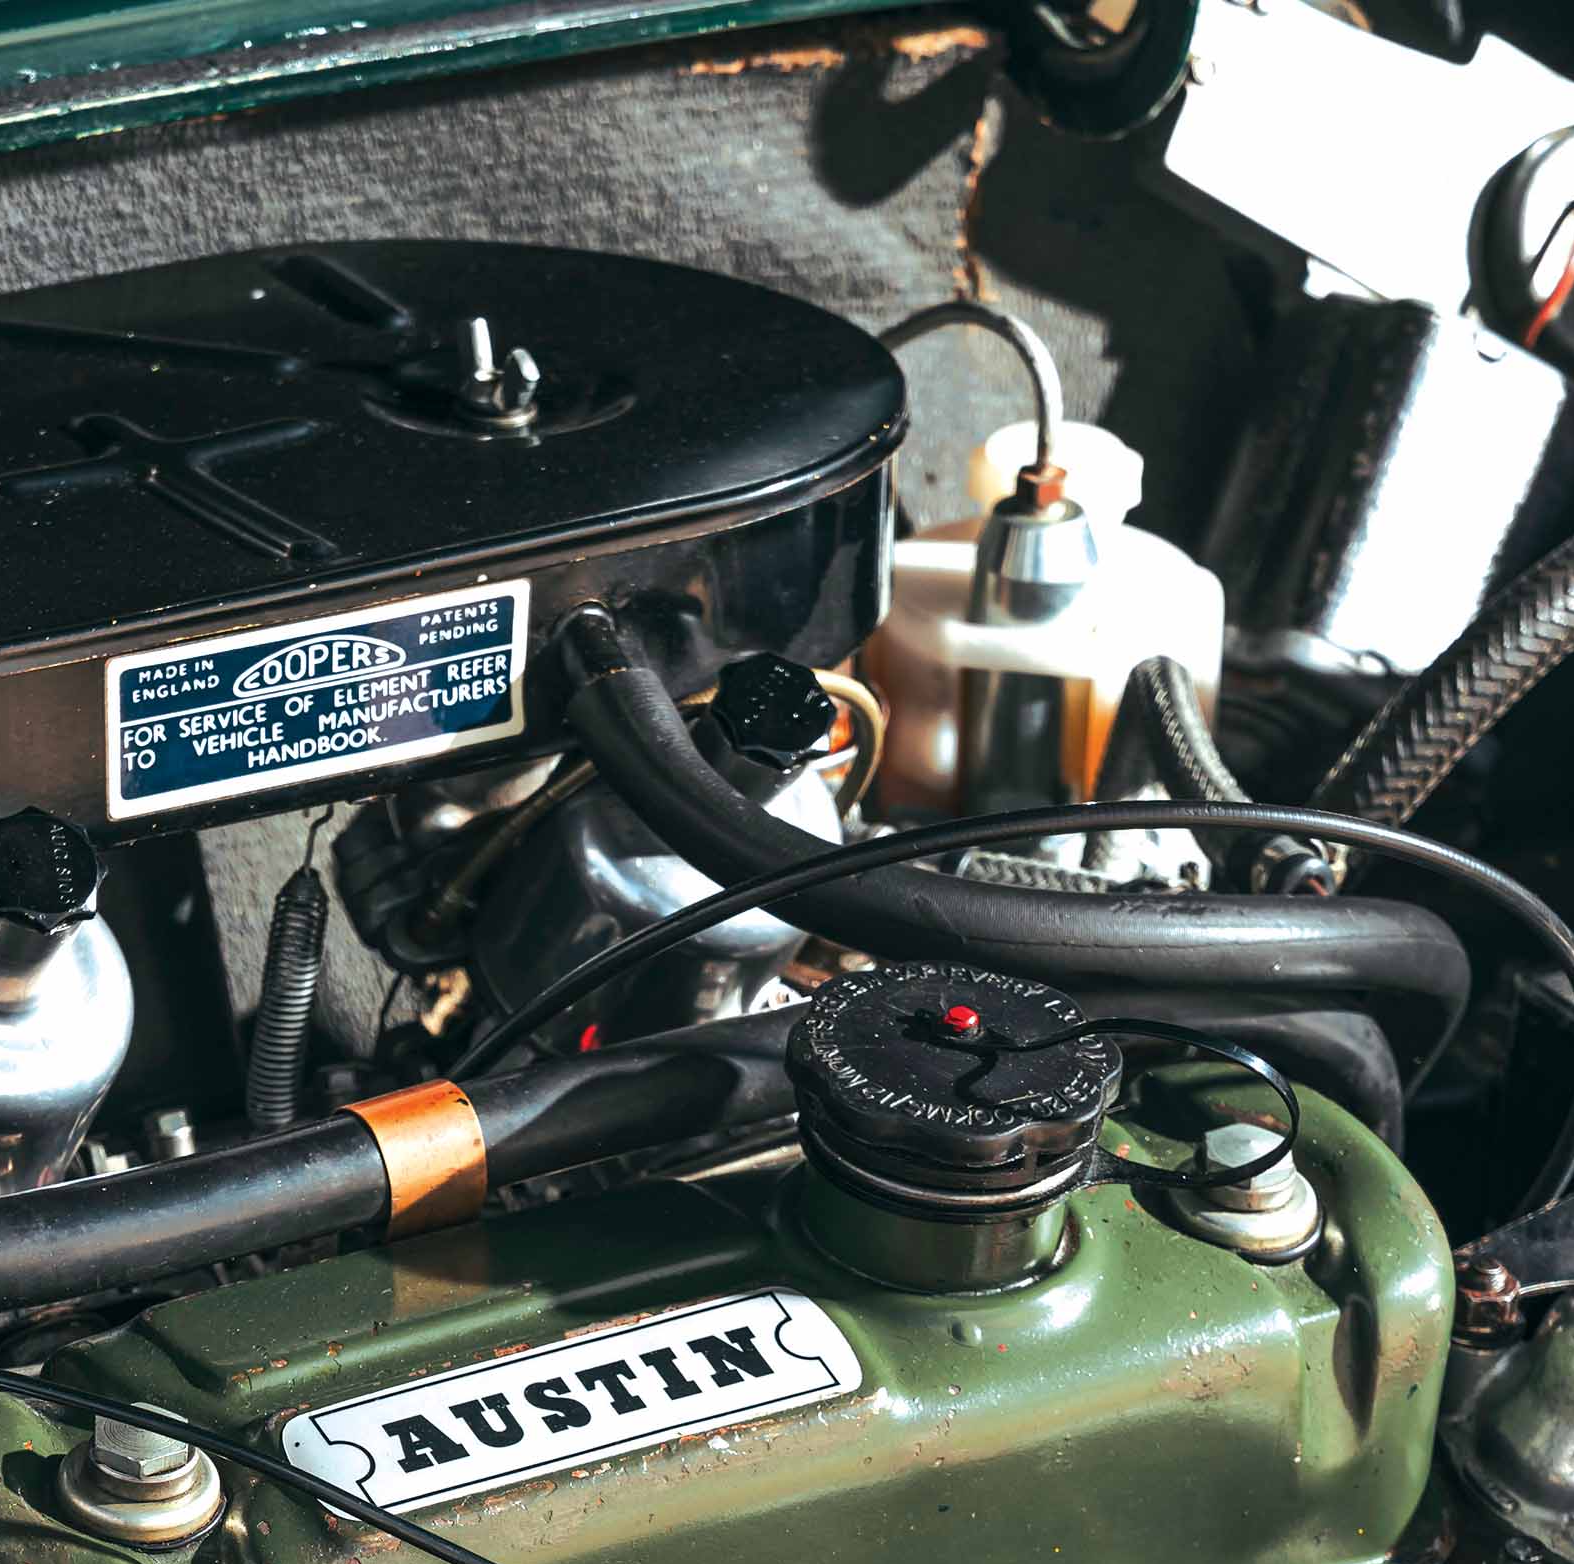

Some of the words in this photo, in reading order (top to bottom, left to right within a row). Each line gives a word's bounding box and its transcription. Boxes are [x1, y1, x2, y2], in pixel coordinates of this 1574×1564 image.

[419, 619, 499, 645] PENDING
[421, 602, 498, 627] PATENTS
[138, 664, 188, 683] MADE
[195, 659, 214, 673] IN
[243, 641, 390, 690] COOPERS
[123, 723, 167, 749] FOR
[179, 703, 267, 738] SERVICE
[284, 694, 314, 717] OF
[334, 669, 432, 708] ELEMENT
[447, 654, 507, 682] REFER
[133, 674, 220, 703] ENGLAND
[123, 749, 156, 771] TO
[192, 722, 284, 756] VEHICLE
[318, 675, 508, 732] MANUFACTURERS
[247, 726, 389, 769] HANDBOOK.
[381, 1325, 775, 1474] AUSTIN
